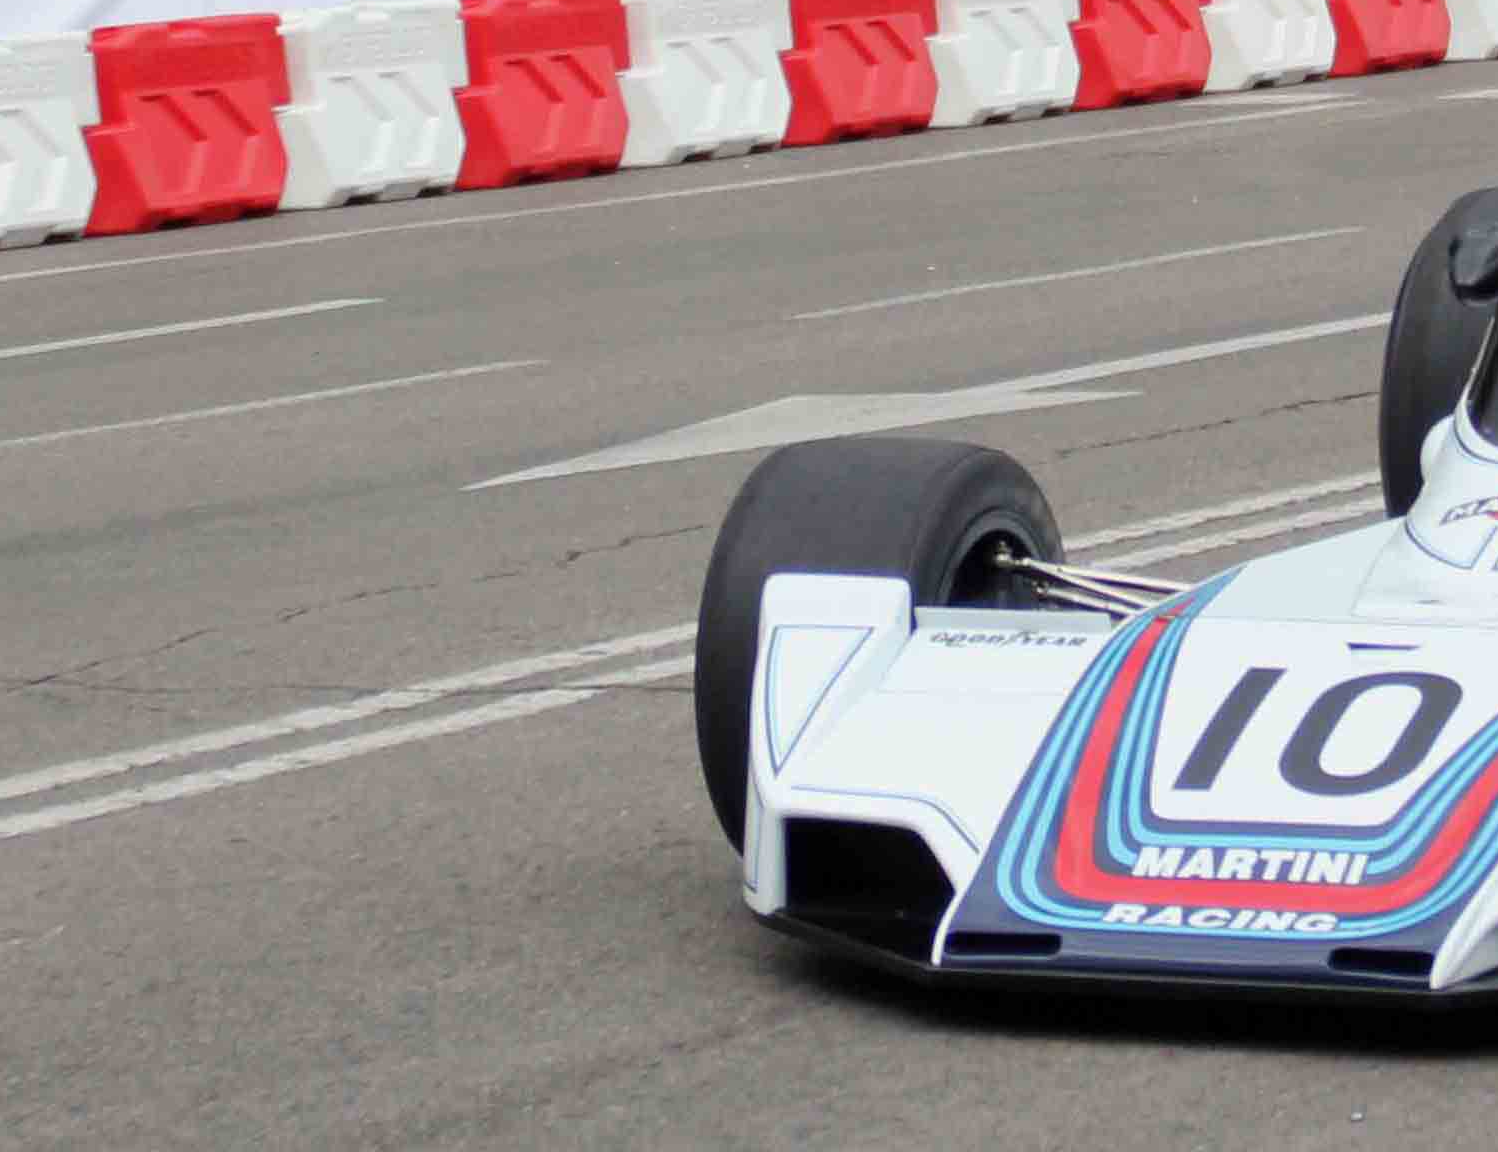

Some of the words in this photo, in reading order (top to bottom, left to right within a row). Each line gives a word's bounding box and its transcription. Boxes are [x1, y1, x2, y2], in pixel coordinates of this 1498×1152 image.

[1171, 667, 1464, 796] 10
[1130, 847, 1370, 887] MARTINI
[1102, 903, 1340, 934] RACING
